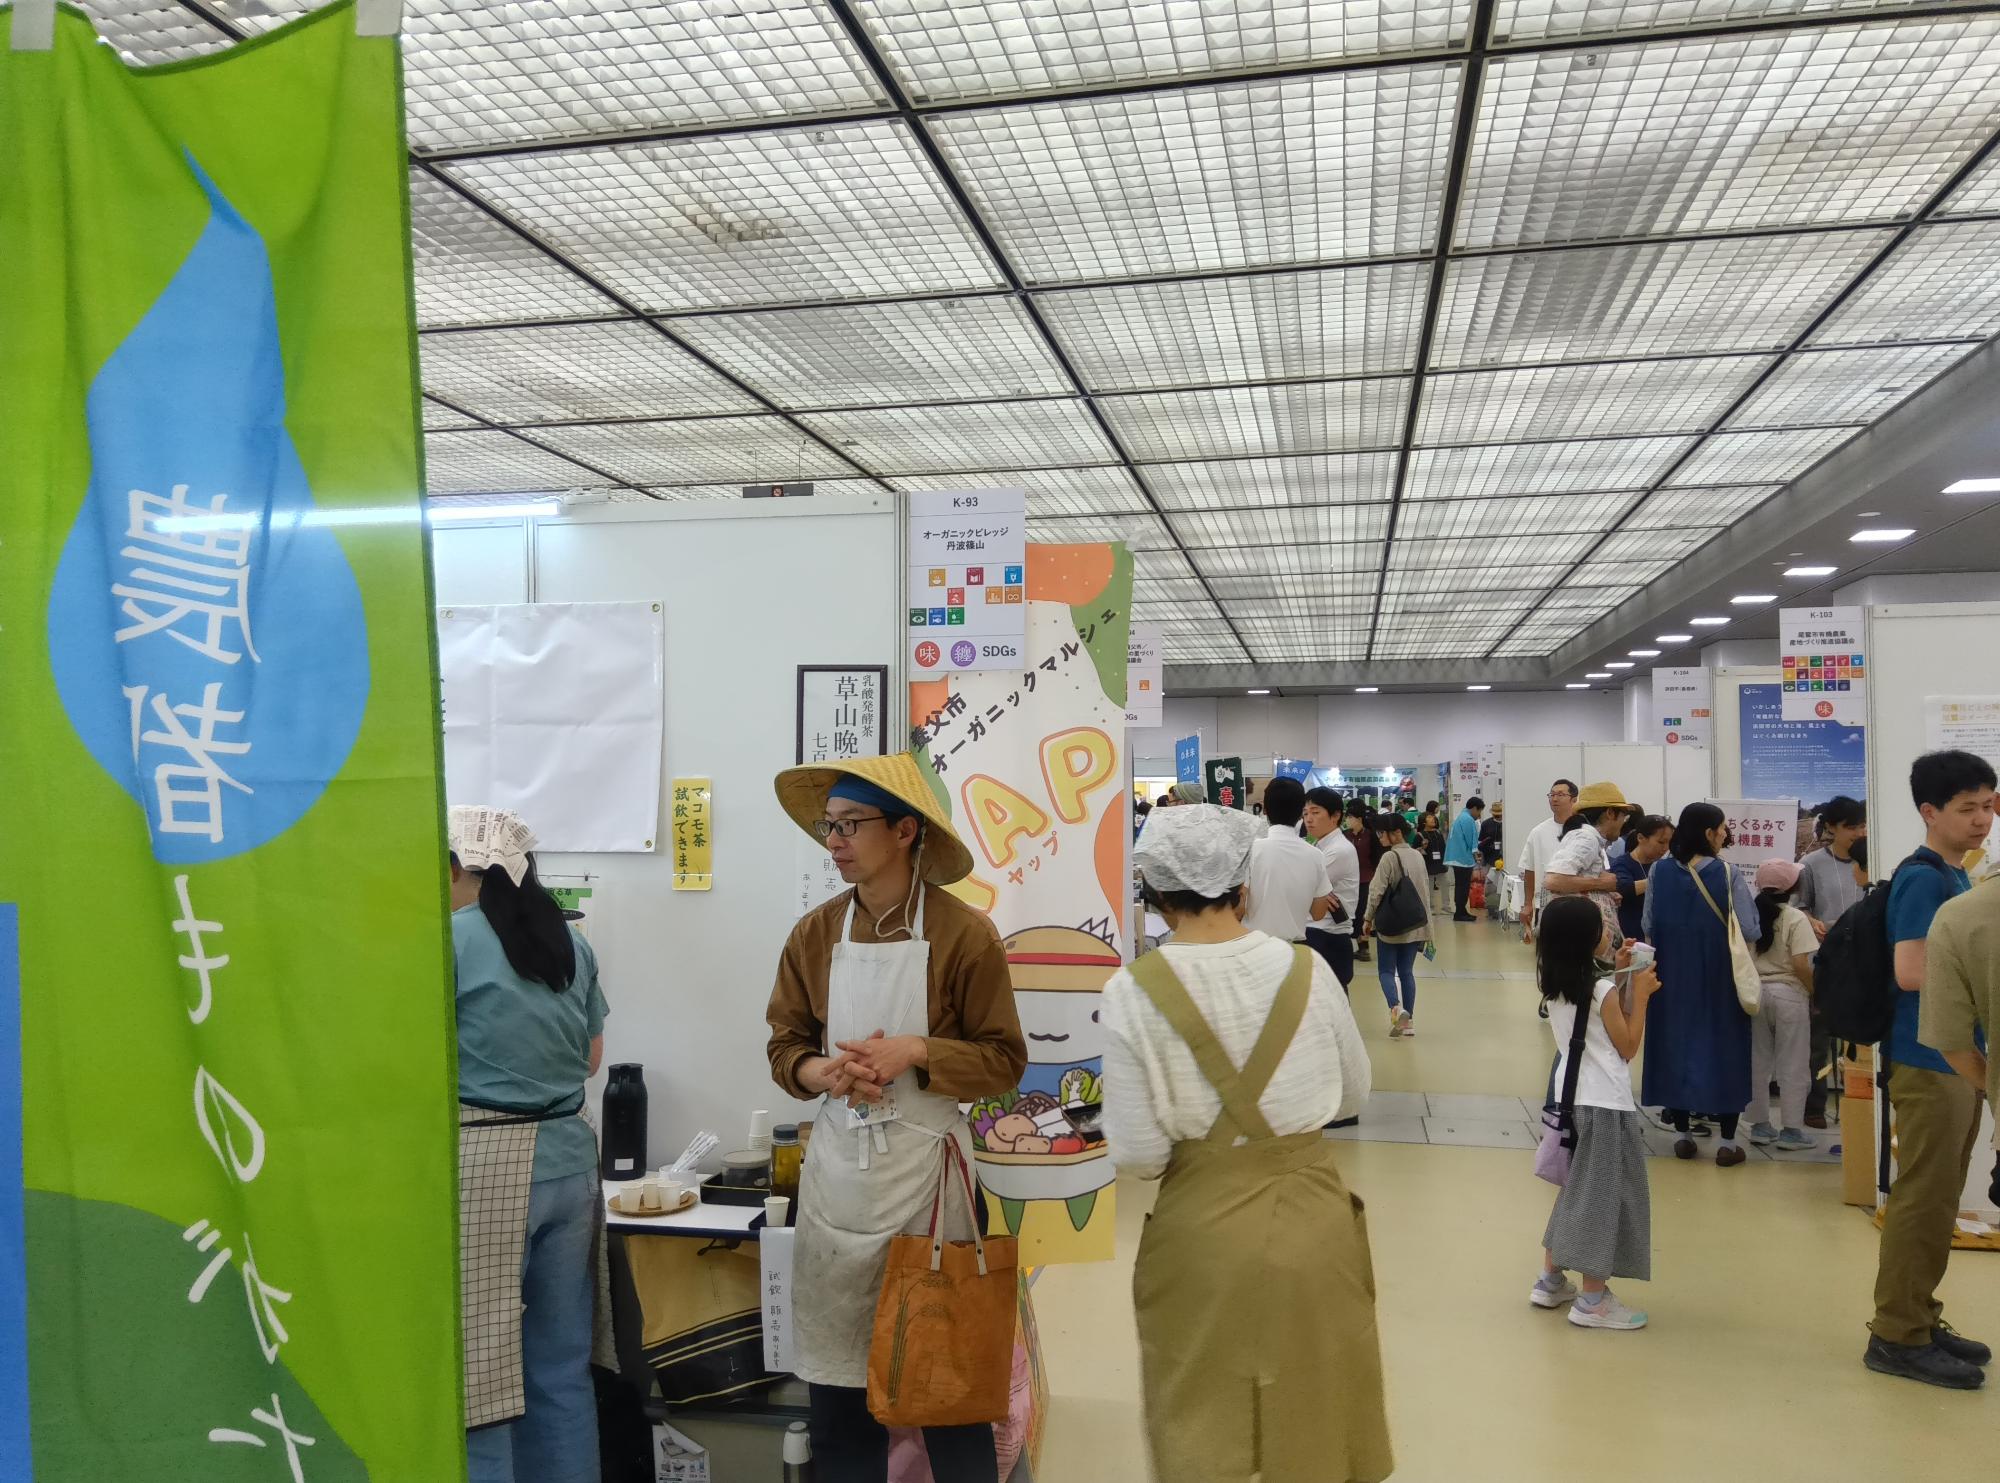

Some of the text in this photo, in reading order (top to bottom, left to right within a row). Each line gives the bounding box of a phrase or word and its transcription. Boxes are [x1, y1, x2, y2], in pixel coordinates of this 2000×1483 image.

[953, 497, 979, 508] K-93
[923, 527, 1009, 540] オーガニックビレッジ
[946, 540, 985, 551] 丹波篠山
[1810, 611, 1833, 619] K-103
[919, 647, 937, 663] 味
[982, 645, 1017, 657] SDGs
[861, 674, 875, 738] 乳酸発酵茶
[931, 608, 1116, 775] オーガニックマルシェ
[834, 675, 859, 759] 草山晩
[910, 692, 967, 753] 養父市
[674, 786, 690, 885] 試飲できます
[691, 787, 707, 848] マコモ茶
[1727, 818, 1786, 832] ちぐるみで
[1007, 830, 1060, 886] ヤップ
